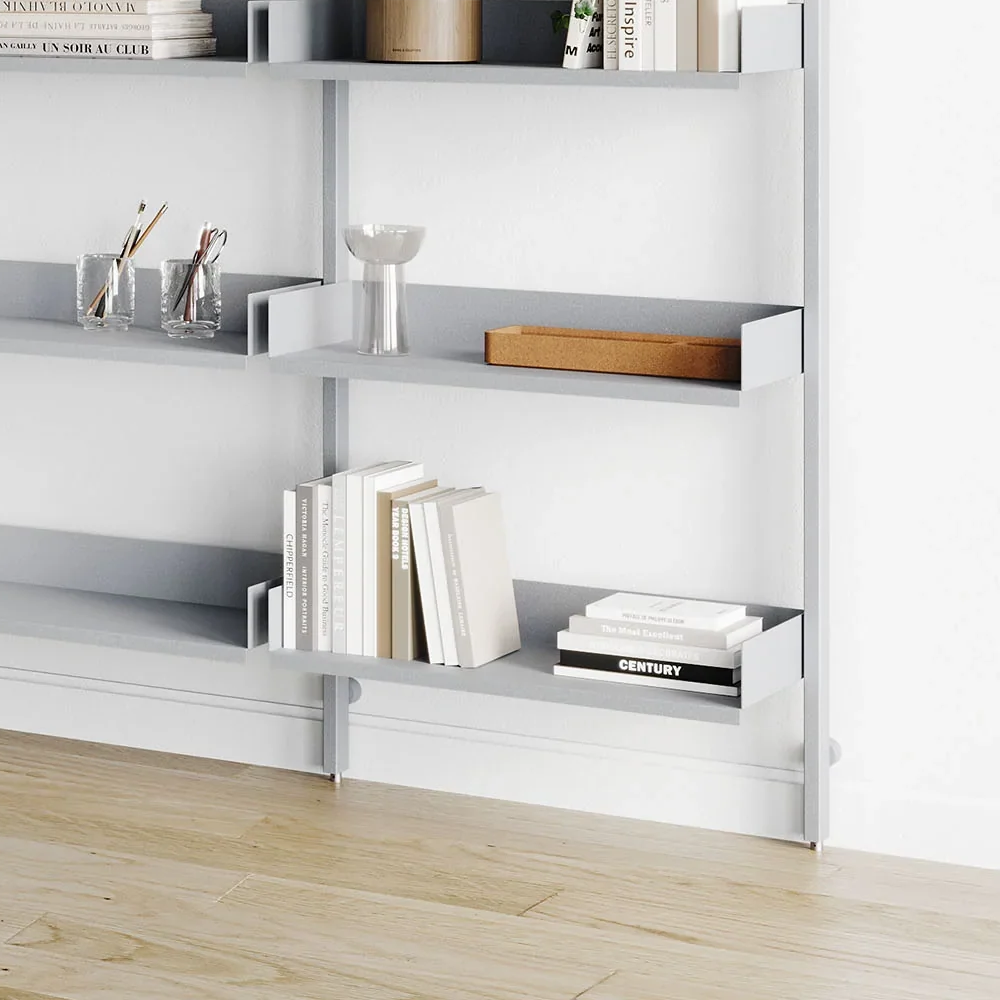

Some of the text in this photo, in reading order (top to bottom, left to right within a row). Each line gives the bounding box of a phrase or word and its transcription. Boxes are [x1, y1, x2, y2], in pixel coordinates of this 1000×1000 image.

[3, 1, 136, 12] MANOLO BLAHNIK
[644, 0, 652, 26] TELLER
[12, 21, 23, 29] LA
[28, 21, 38, 29] DE
[75, 22, 85, 30] LA
[621, 2, 637, 58] Inspire
[588, 27, 600, 37] Art
[10, 42, 37, 50] GAILLY
[42, 43, 60, 52] UN
[63, 43, 92, 53] SOIR
[95, 44, 111, 54] AU
[116, 44, 149, 54] CLUB
[566, 45, 578, 56] M
[608, 49, 616, 60] EL
[286, 534, 294, 598] CHIPPERFIELD
[601, 624, 684, 641] The Most Excellent
[618, 659, 682, 676] CENTURY
